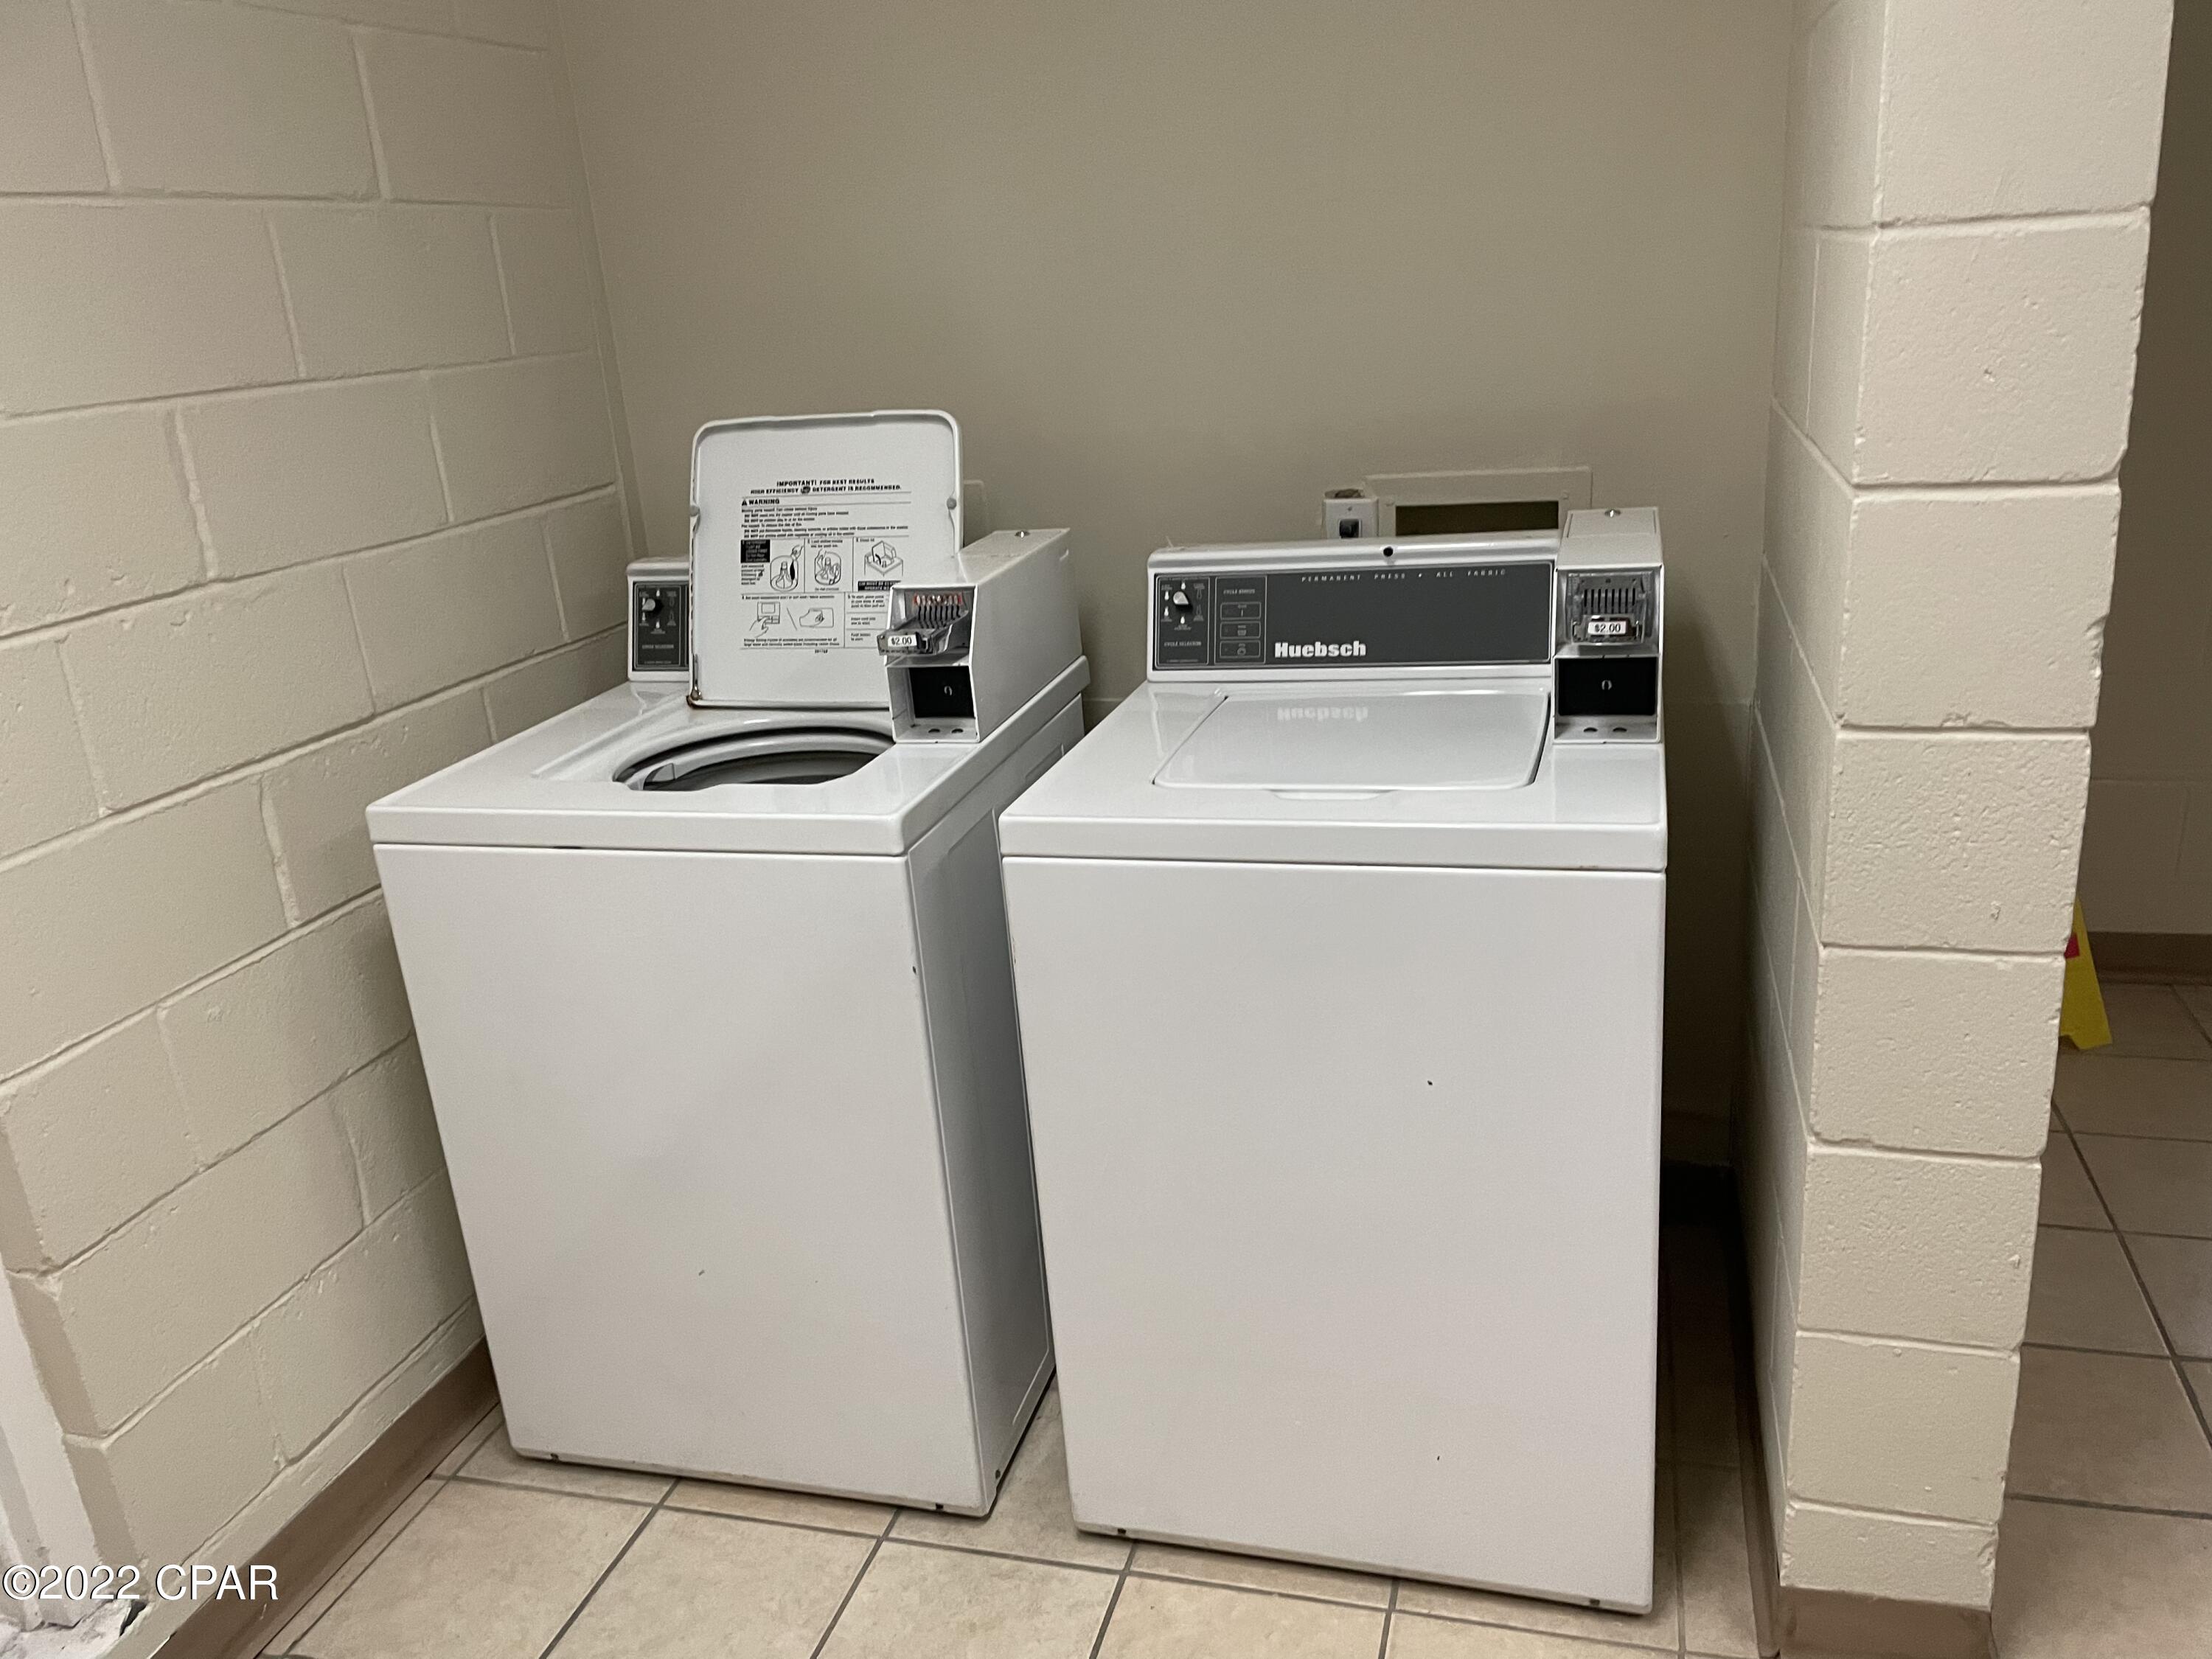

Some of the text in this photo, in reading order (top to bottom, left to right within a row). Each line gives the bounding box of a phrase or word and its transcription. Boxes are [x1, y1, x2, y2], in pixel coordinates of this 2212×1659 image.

[776, 479, 817, 487] IMPORTANT!
[1301, 574, 1361, 582] PERMANENT
[1467, 568, 1506, 577] FABRIC
[1594, 624, 1621, 633] $2.00
[891, 636, 912, 645] $2.00
[1274, 641, 1366, 658] Huebsch
